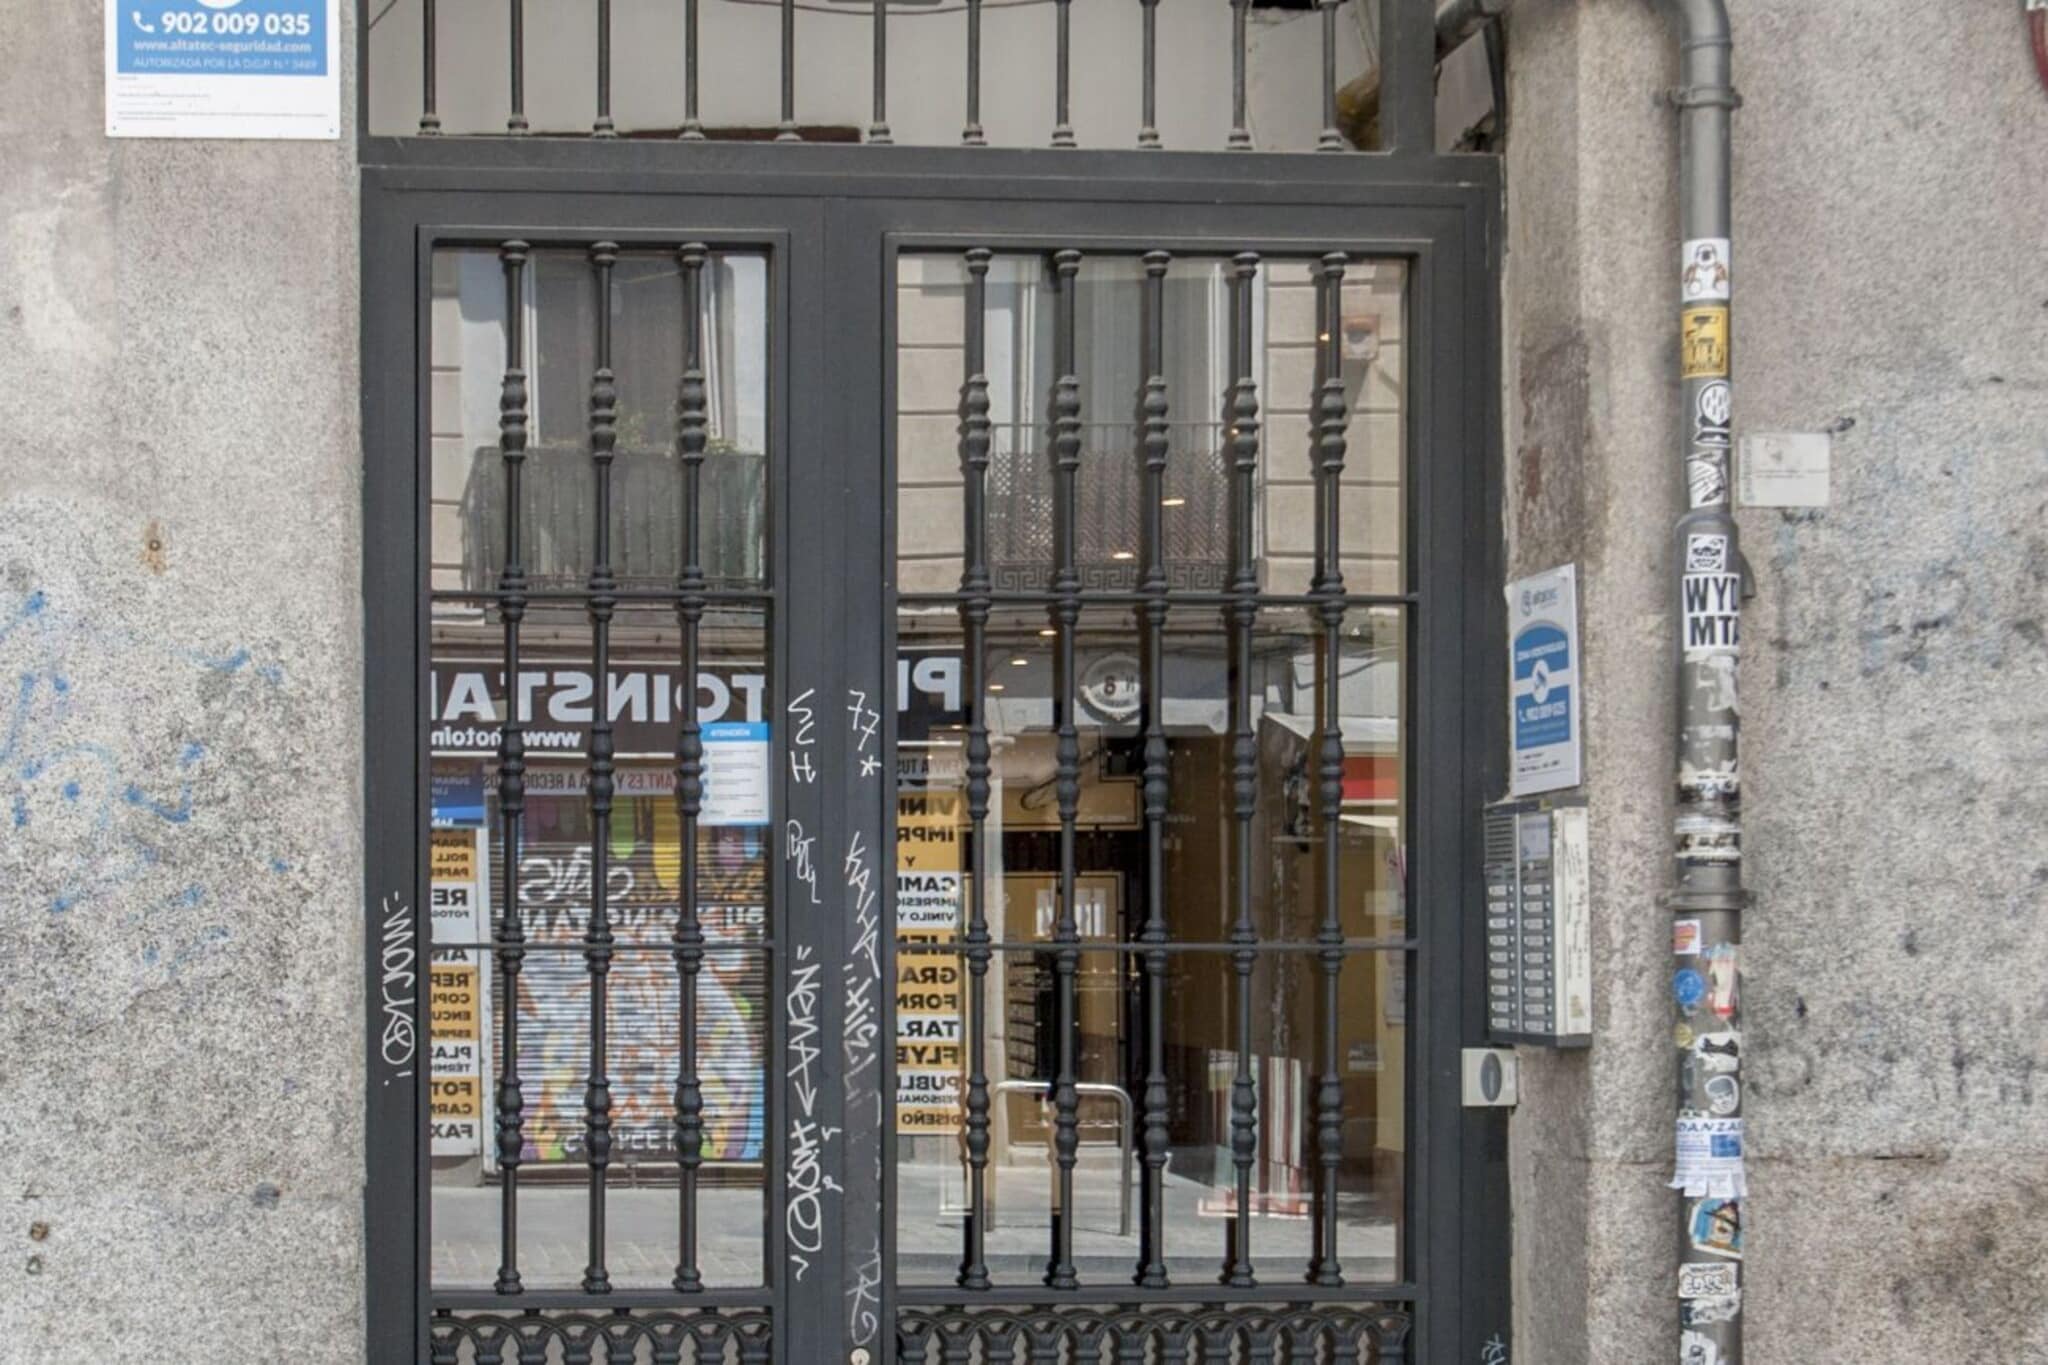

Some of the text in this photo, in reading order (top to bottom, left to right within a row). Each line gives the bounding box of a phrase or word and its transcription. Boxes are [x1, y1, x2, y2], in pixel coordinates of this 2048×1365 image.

[161, 11, 311, 36] 902 009 035
